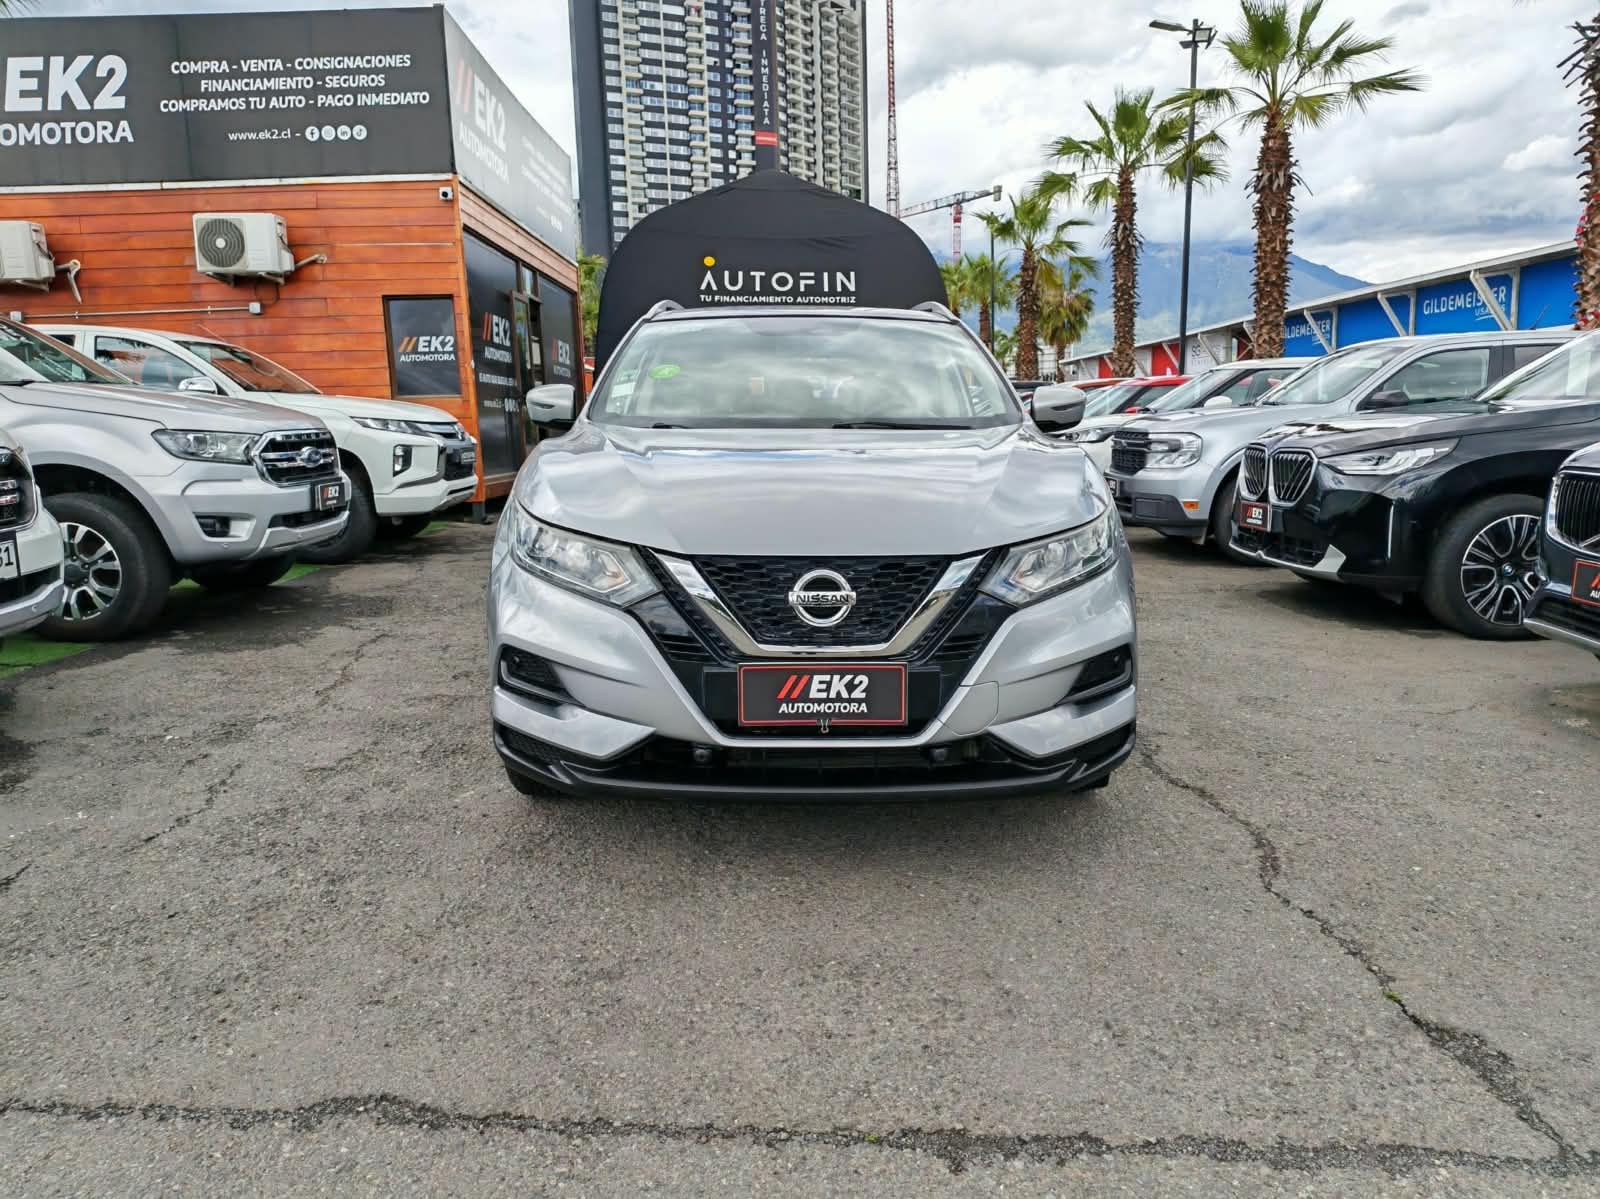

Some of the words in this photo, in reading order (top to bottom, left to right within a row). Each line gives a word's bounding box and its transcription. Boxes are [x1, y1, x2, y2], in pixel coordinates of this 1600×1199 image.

[171, 60, 229, 74] COMPRA
[240, 58, 284, 72] VENTA
[294, 54, 412, 70] CONSIGNACIONES
[4, 54, 128, 112] EK2
[200, 76, 314, 93] FINANCIAMIENTO
[325, 74, 386, 88] SEGUROS
[760, 49, 770, 125] INMEDIATA
[159, 97, 246, 113] COMPRAMOS
[249, 96, 266, 110] TU
[269, 95, 306, 109] AUTO
[317, 93, 354, 108] PAGO
[357, 91, 430, 106] INMEDIATO
[473, 73, 507, 153] EK2
[228, 128, 292, 141] www.ek2.cl
[458, 120, 510, 185] AUTOMOTORA
[700, 269, 857, 293] AUTOFIN
[700, 294, 712, 303] TU
[714, 295, 794, 304] FINANCIAMIENTO
[796, 296, 857, 304] AUTOMOTRIZ
[492, 314, 512, 347] EK2
[417, 335, 455, 353] EK2
[399, 353, 456, 363] AUTOMOTORA
[796, 594, 850, 604] NISSAN
[809, 674, 870, 699] EK2
[778, 702, 868, 714] AUTOMOTORA
